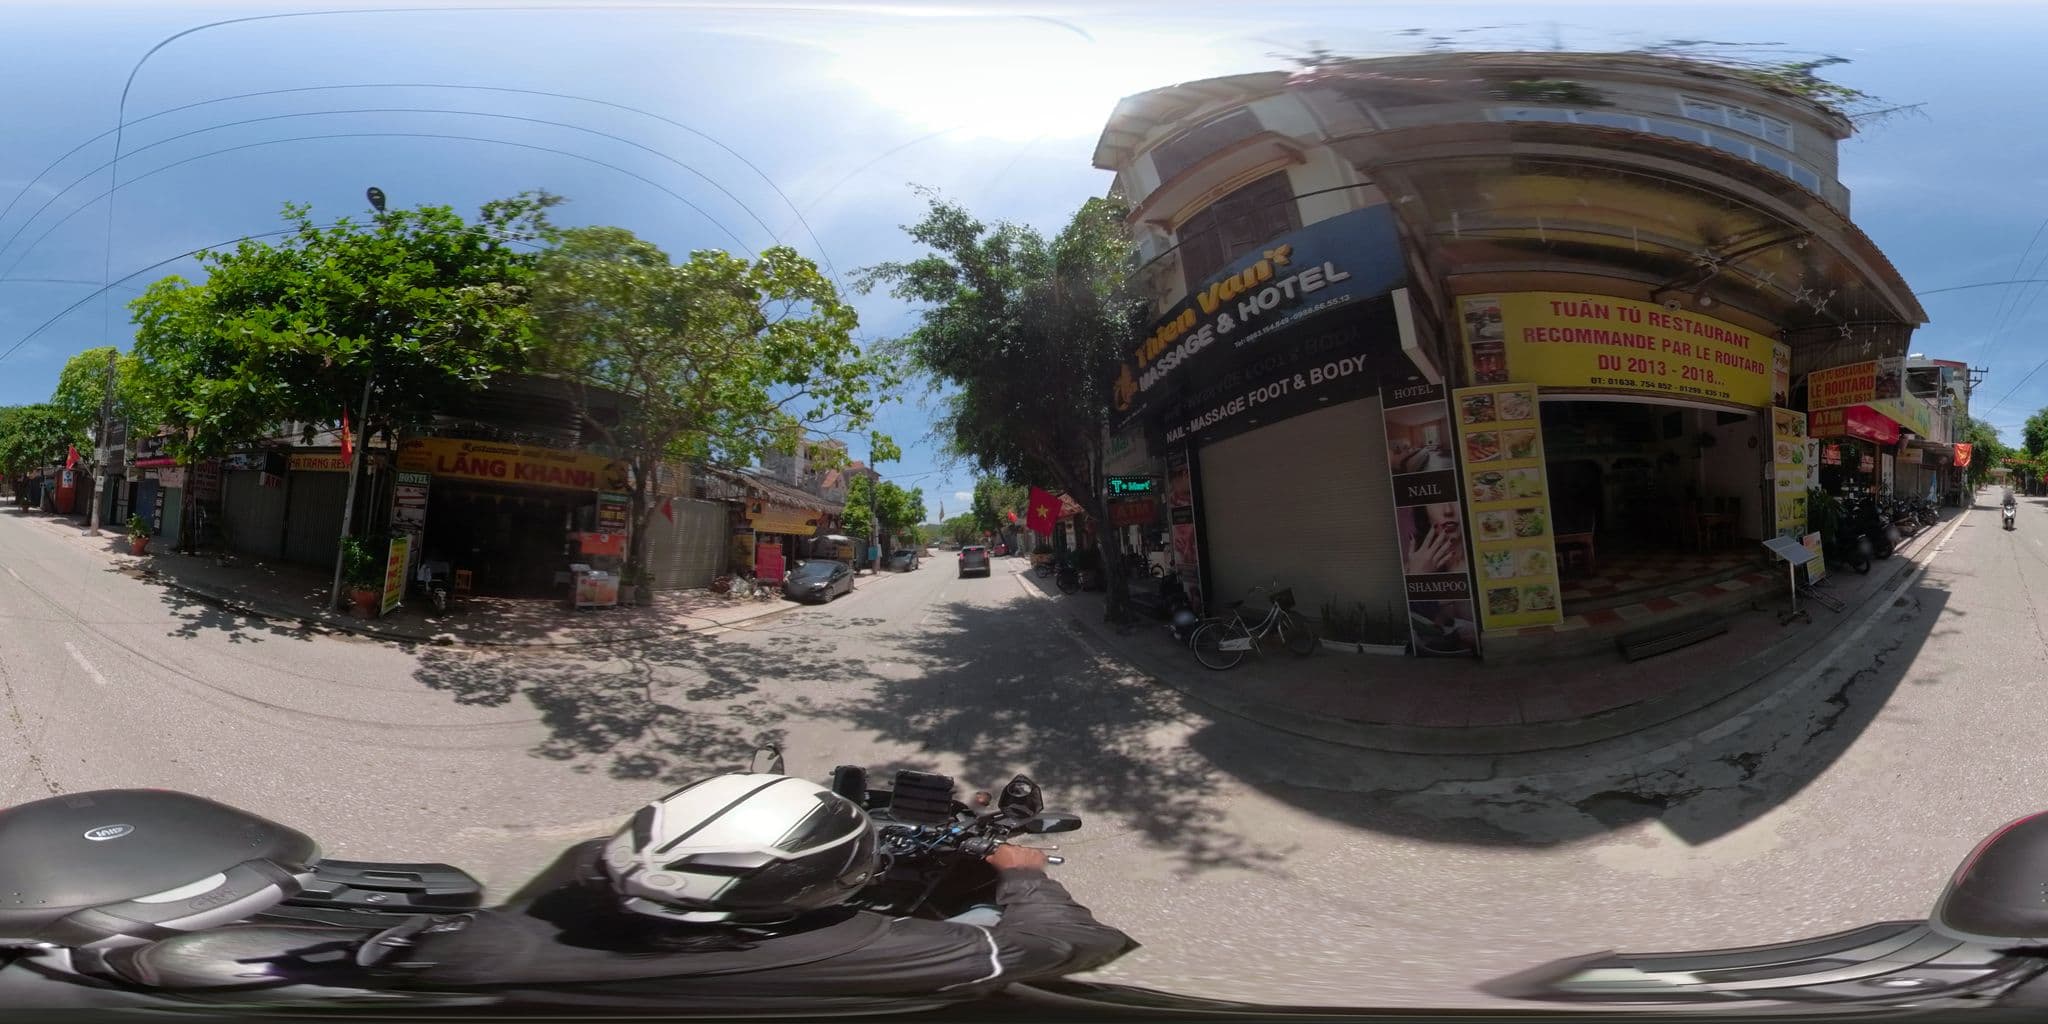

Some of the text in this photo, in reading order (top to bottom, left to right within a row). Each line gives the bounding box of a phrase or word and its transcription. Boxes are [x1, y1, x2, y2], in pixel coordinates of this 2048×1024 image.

[1138, 261, 1352, 392] MASSAGE & HOTEL
[1648, 311, 1751, 349] RESTAURANT
[1523, 327, 1766, 375] RECOMMANDE PAR LE ROUTARD
[1599, 354, 1621, 371] DU
[1628, 357, 1666, 376] 2013
[1393, 384, 1434, 400] HOTEL
[1811, 375, 1874, 398] LE ROUTARD
[1166, 426, 1187, 444] NAIL
[1190, 396, 1246, 433] MASSAGE
[1248, 377, 1290, 407] FOOT
[1292, 373, 1307, 391] &
[1309, 353, 1367, 386] BODY
[1407, 484, 1442, 497] NAIL
[1408, 581, 1467, 593] SHAMPOO
